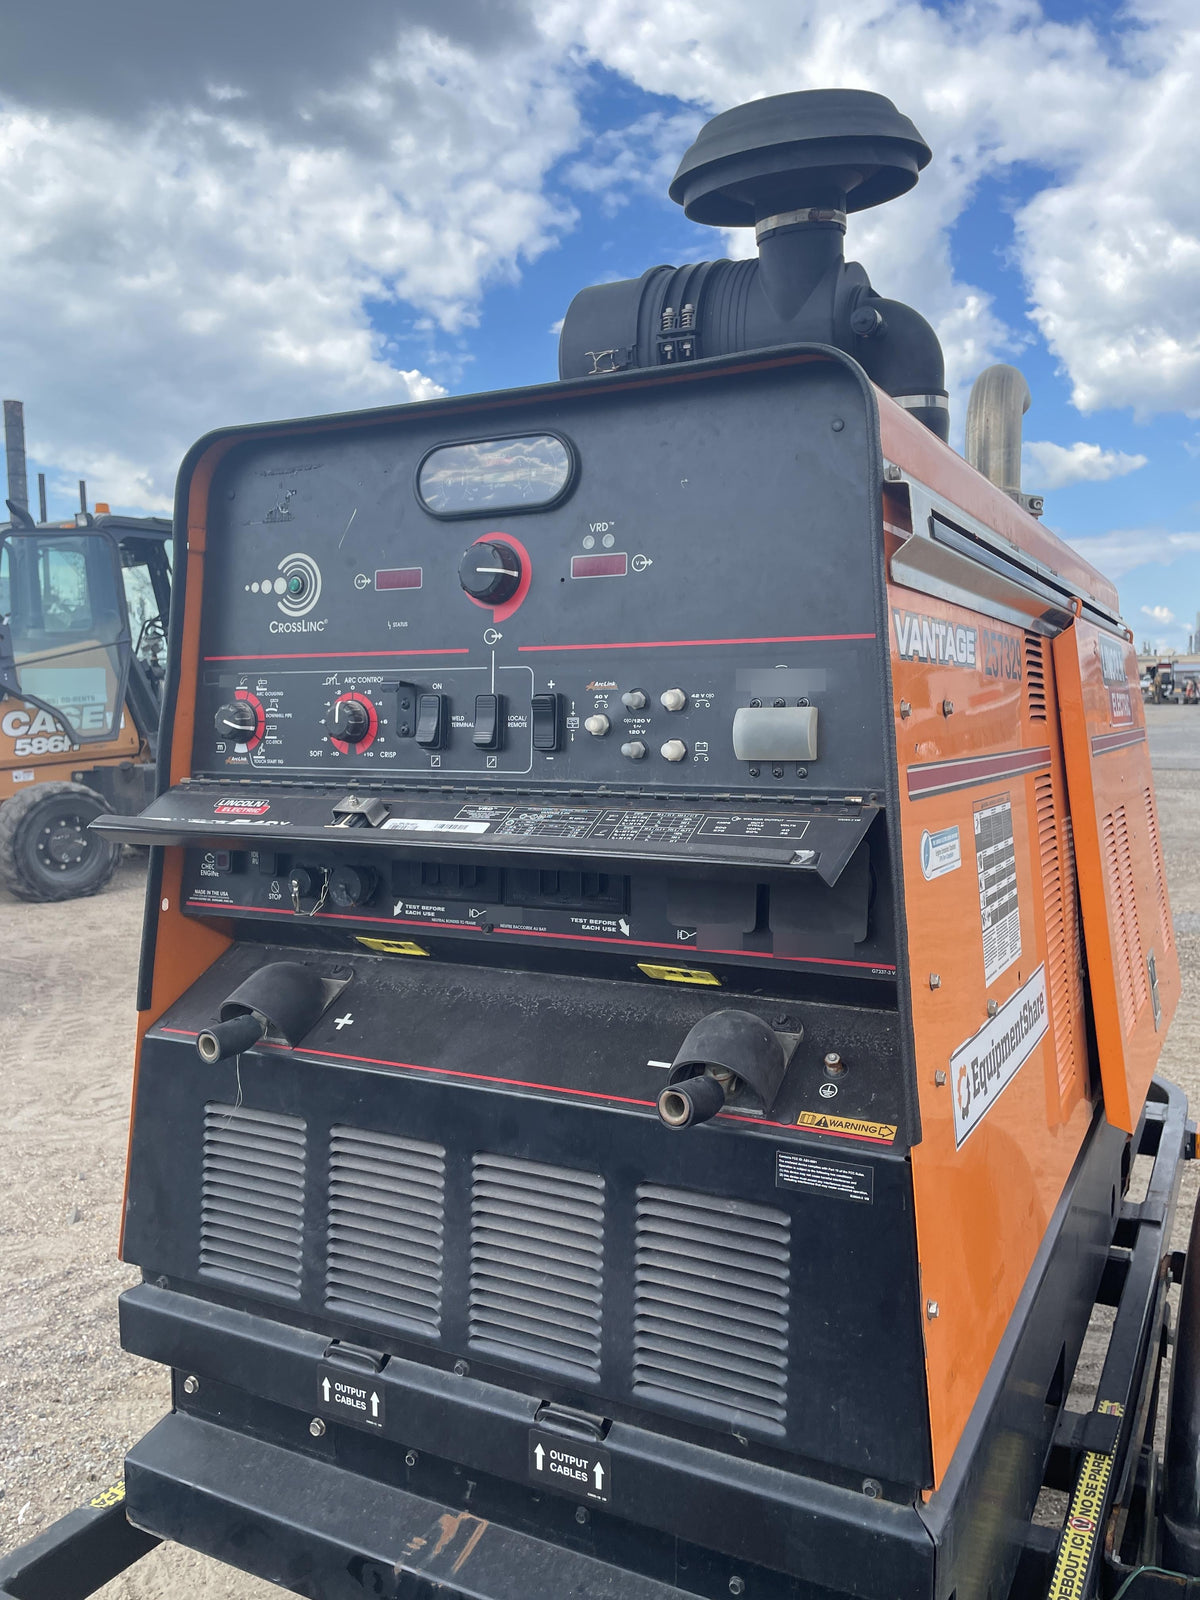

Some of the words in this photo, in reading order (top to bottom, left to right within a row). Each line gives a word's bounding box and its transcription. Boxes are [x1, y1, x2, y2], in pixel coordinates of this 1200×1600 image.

[893, 609, 977, 668] VANTAGE
[344, 676, 357, 684] ARC
[432, 682, 443, 690] ON
[451, 721, 475, 729] TERMINAL
[507, 721, 527, 729] REMOTE
[379, 751, 397, 759] CRISP
[217, 799, 265, 808] LINCOLN
[220, 806, 262, 814] ELECTRIC
[268, 893, 282, 901] STOP
[970, 991, 1045, 1100] EquipmentShare
[829, 1119, 878, 1134] WARNING
[334, 1382, 367, 1399] OUTPUT
[334, 1394, 367, 1410] CABLES
[549, 1449, 588, 1470] OUTPUT
[549, 1462, 588, 1482] CABLES
[1084, 1482, 1098, 1499] SE
[1079, 1499, 1094, 1517] NO
[1070, 1533, 1086, 1551] ICI
